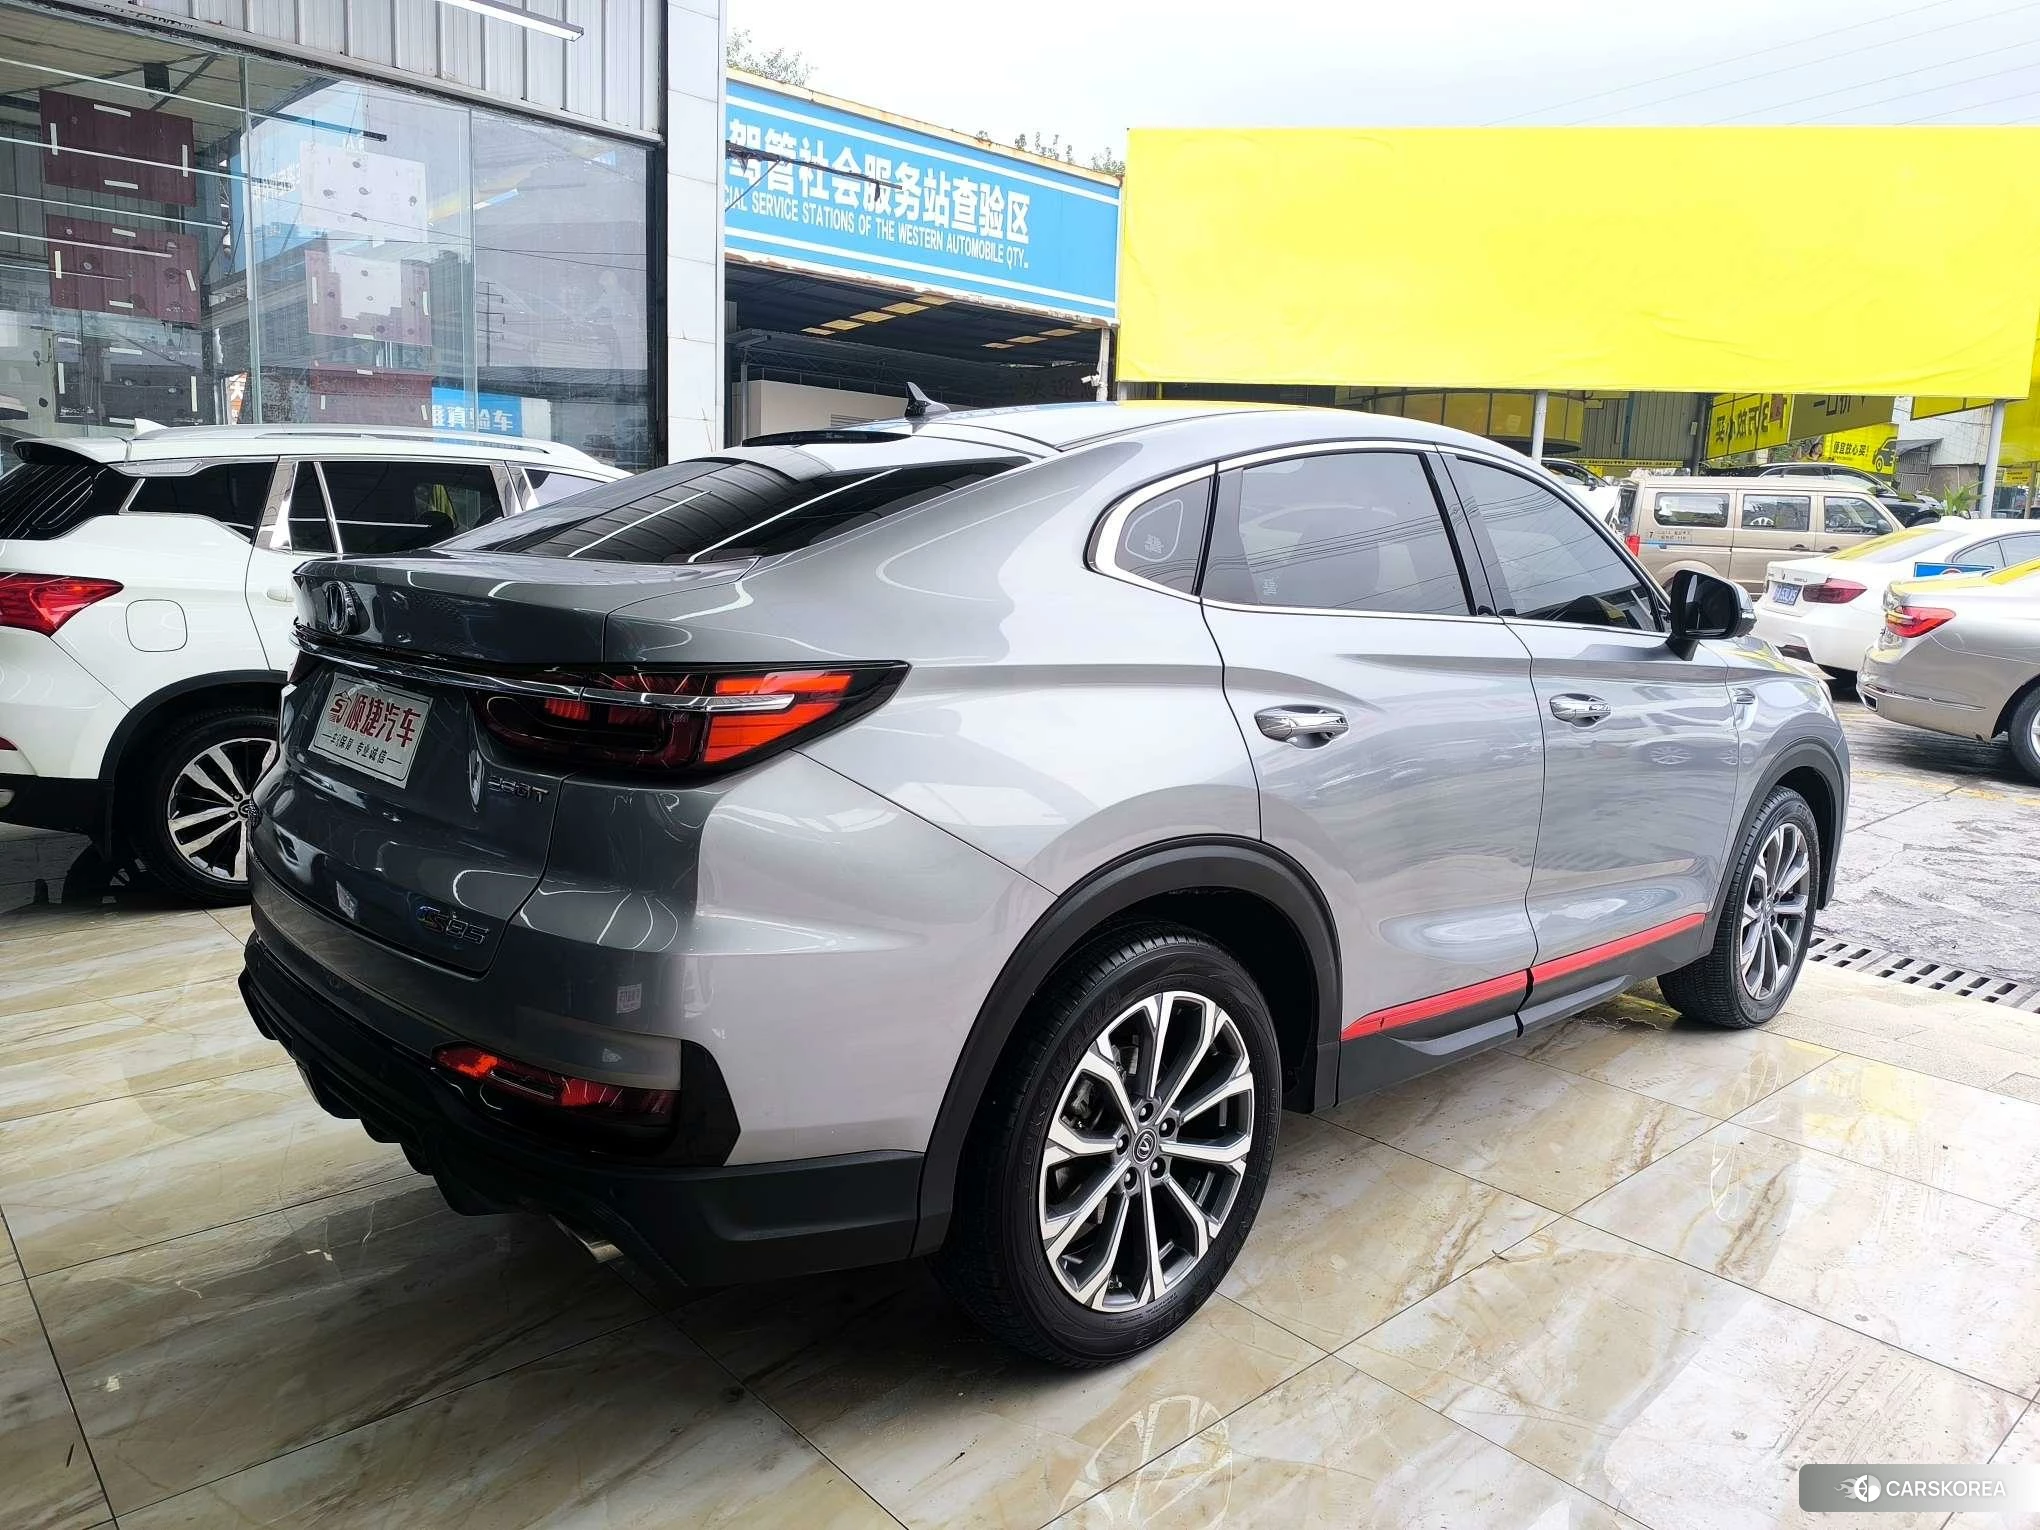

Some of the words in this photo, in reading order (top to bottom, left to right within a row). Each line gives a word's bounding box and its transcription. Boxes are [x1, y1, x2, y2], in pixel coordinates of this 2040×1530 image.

[752, 191, 799, 222] SERVICE
[803, 202, 855, 234] STATIONS
[858, 214, 872, 236] OF
[875, 217, 895, 242] THE
[898, 222, 944, 251] WESTERN
[946, 233, 1004, 265] AUTOMOBILE
